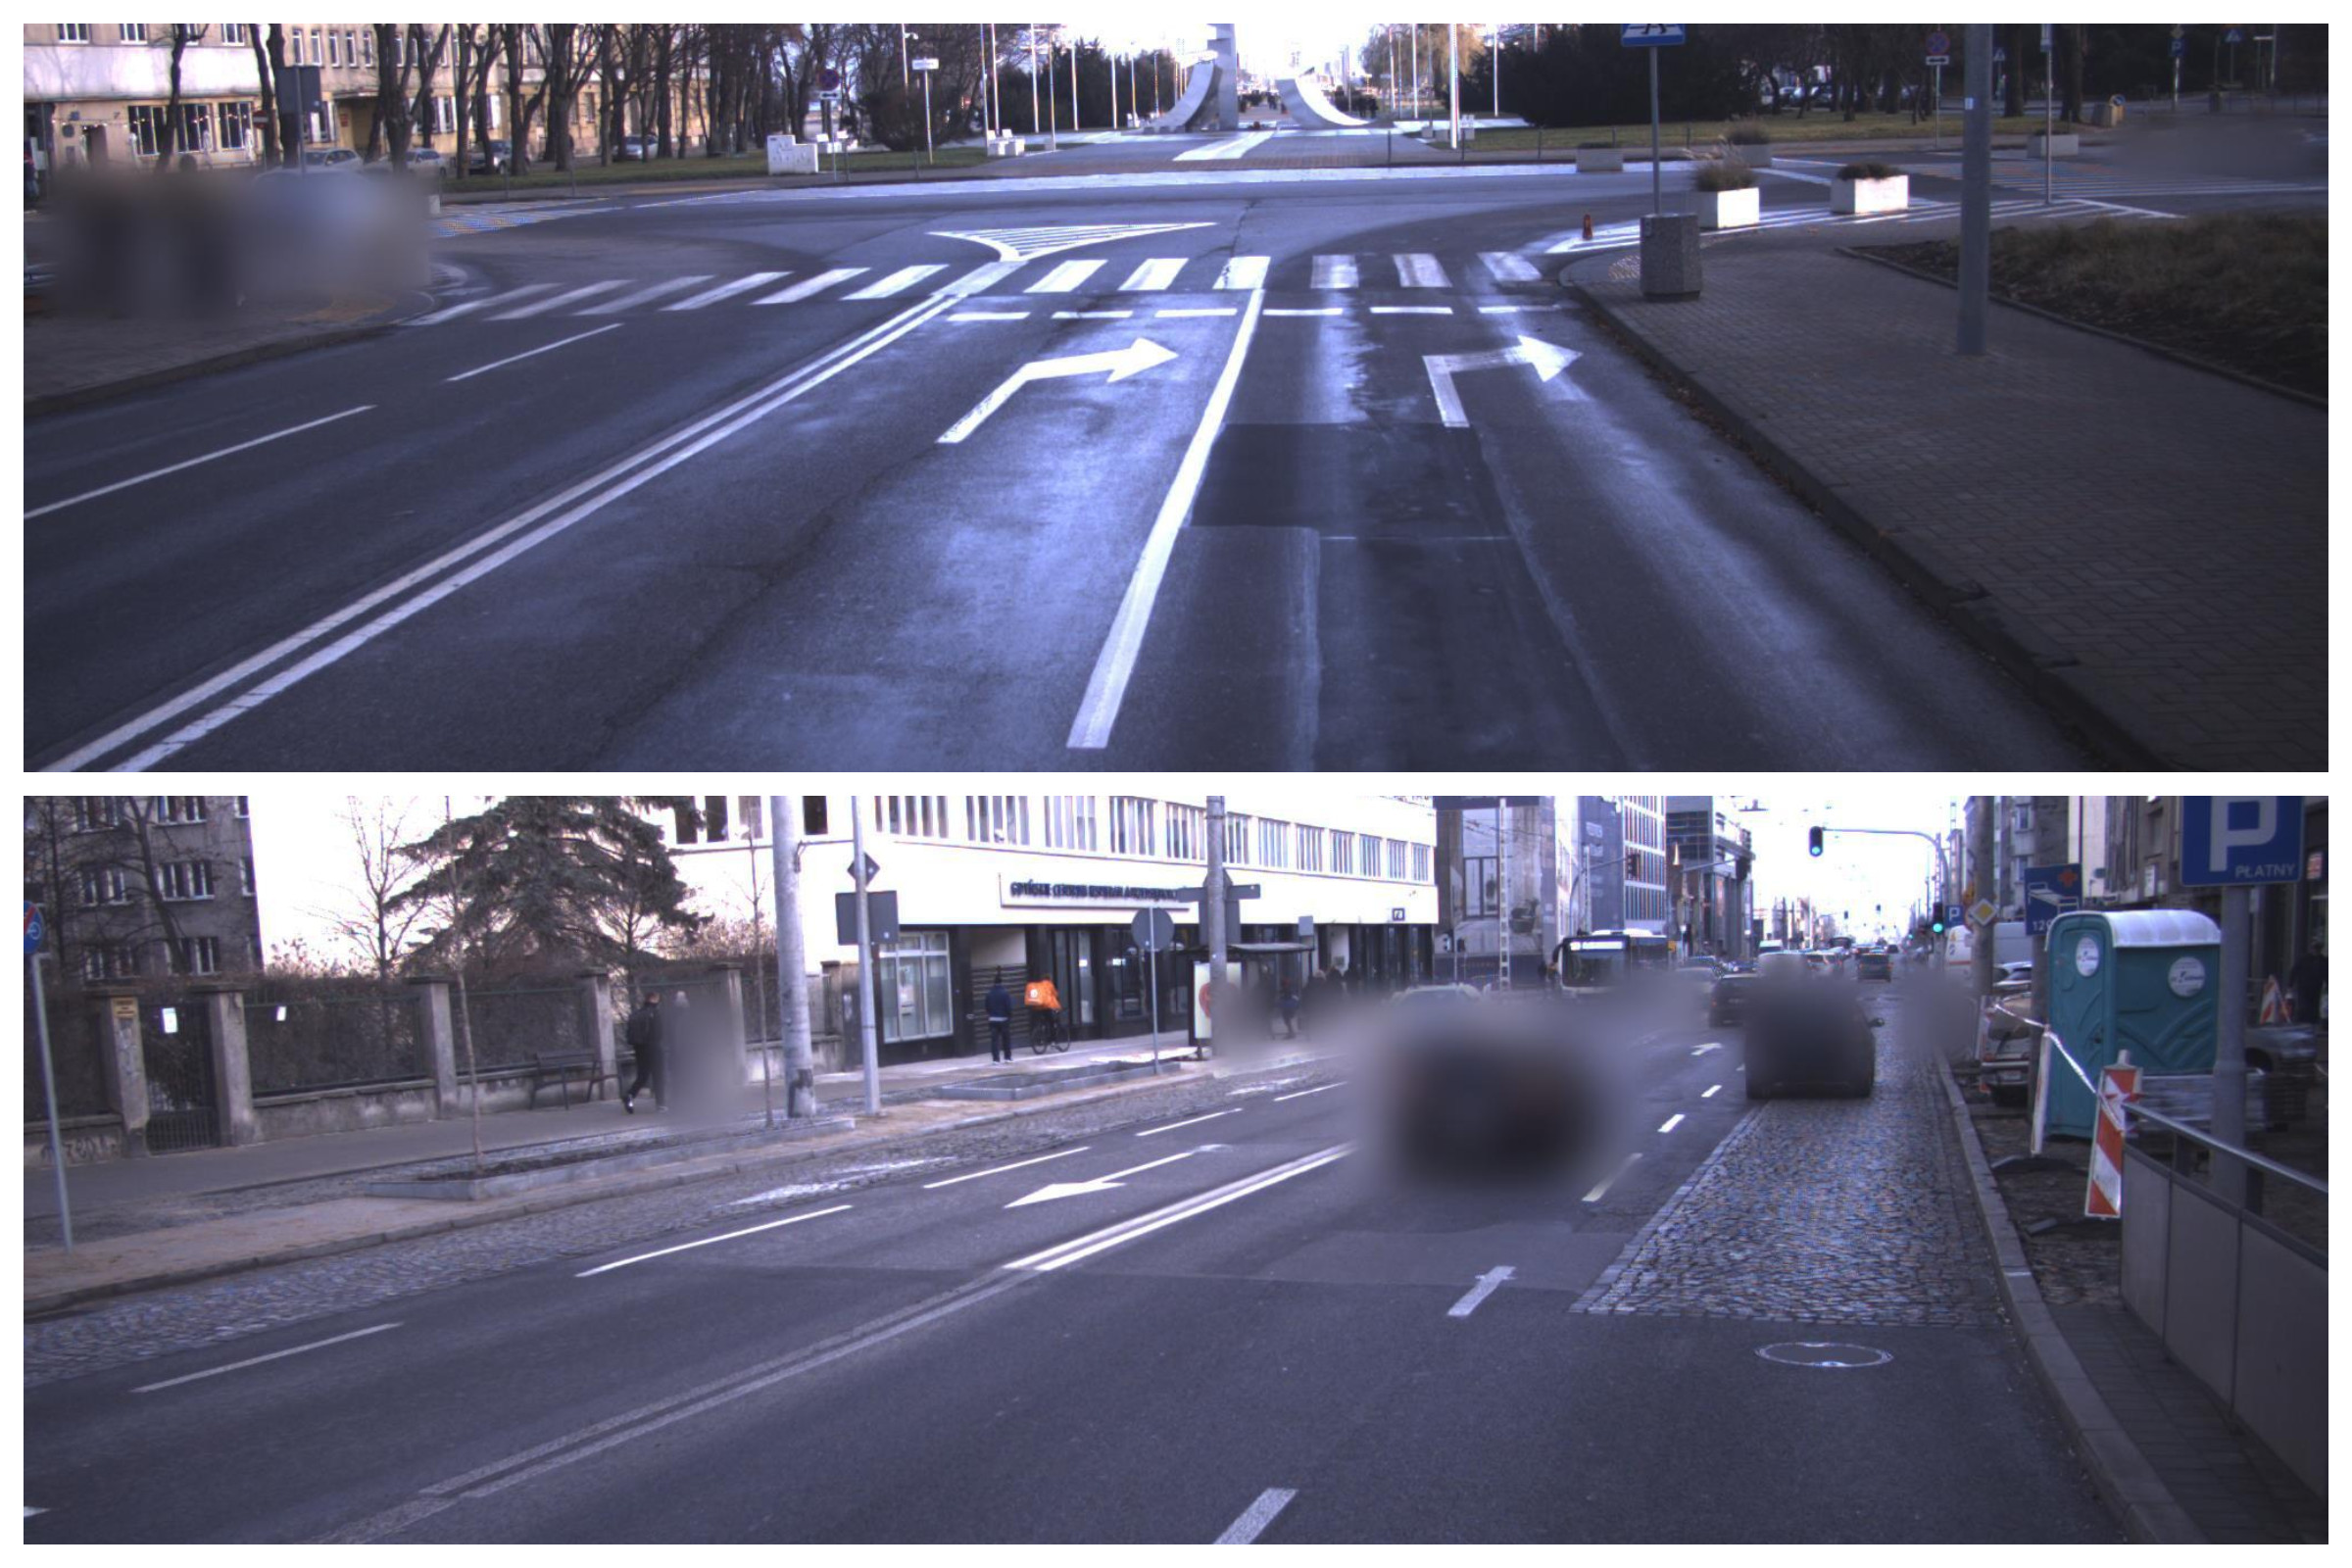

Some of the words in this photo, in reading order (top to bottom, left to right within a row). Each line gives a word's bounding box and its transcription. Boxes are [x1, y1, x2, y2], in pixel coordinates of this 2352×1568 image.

[2209, 796, 2278, 872] P
[2235, 863, 2296, 878] PŁATNY
[1949, 906, 1960, 922] P
